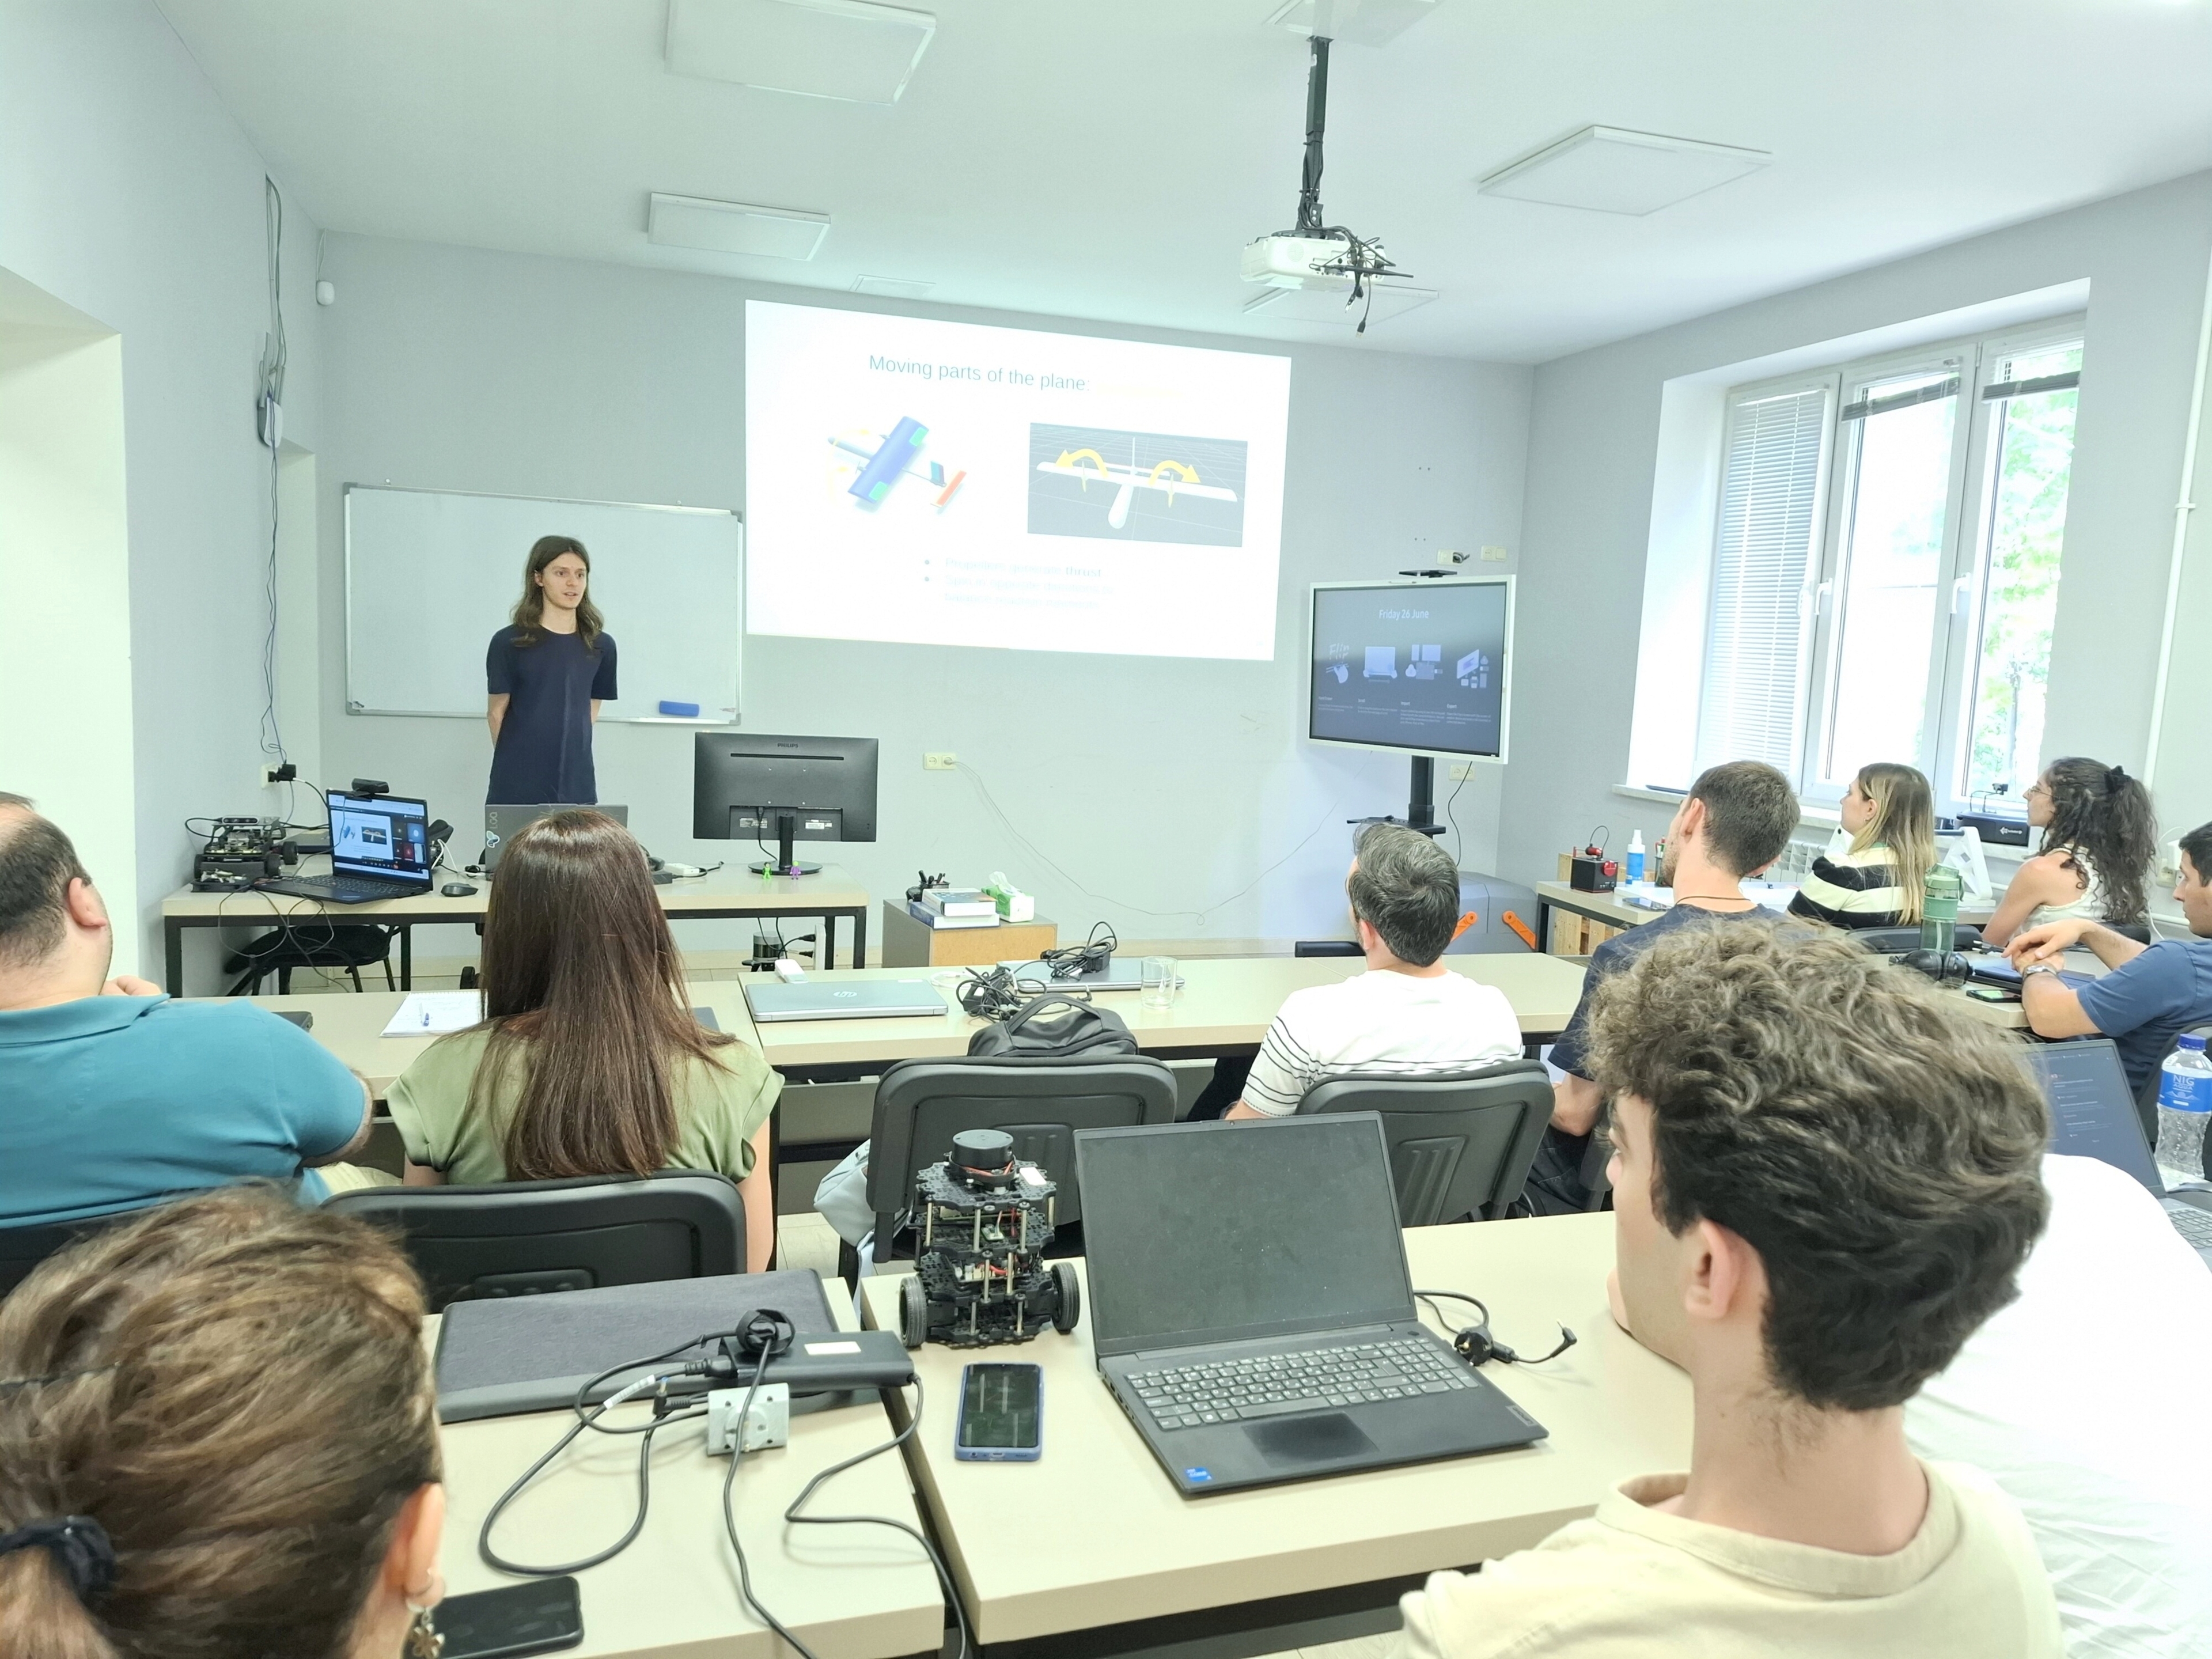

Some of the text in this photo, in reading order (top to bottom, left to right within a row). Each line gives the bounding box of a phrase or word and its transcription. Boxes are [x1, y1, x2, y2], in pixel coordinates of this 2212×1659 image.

[870, 355, 932, 378] Moving
[938, 363, 981, 380] parts
[987, 368, 1003, 382] of
[1009, 369, 1034, 385] the
[1040, 373, 1090, 391] plane:
[1066, 566, 1102, 577] thrust
[1379, 609, 1429, 621] Friday 26 June
[2173, 1075, 2194, 1085] NIG
